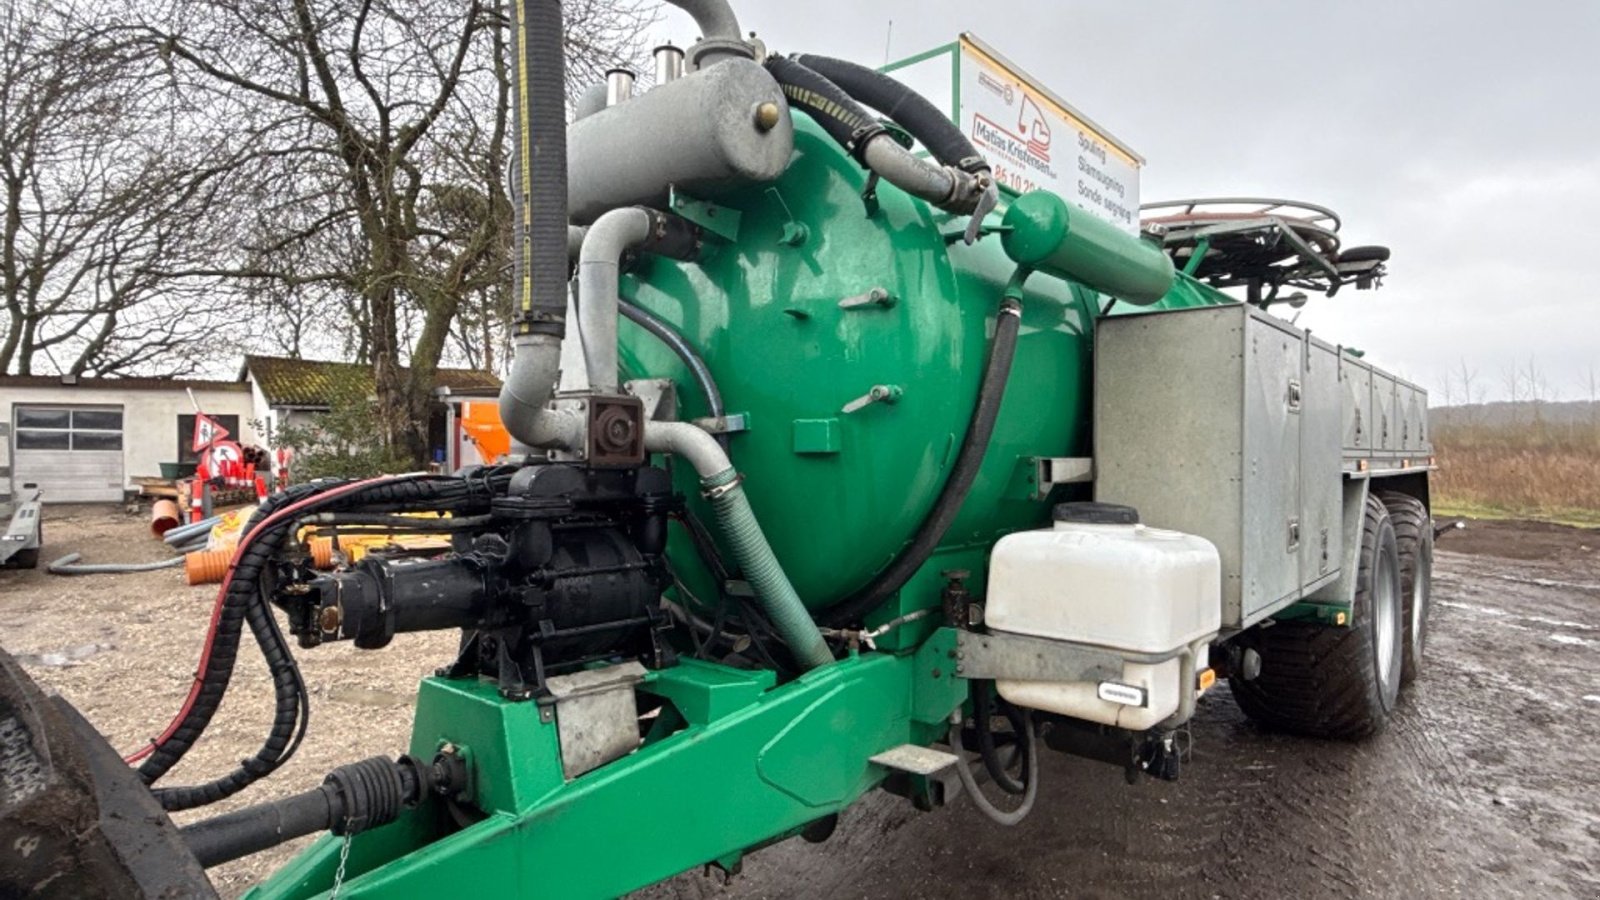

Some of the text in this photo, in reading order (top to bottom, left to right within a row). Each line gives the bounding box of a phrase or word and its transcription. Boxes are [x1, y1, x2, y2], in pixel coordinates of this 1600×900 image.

[976, 121, 1006, 151] Matias
[1007, 139, 1050, 176] Kristensen
[1078, 180, 1102, 205] Sonde
